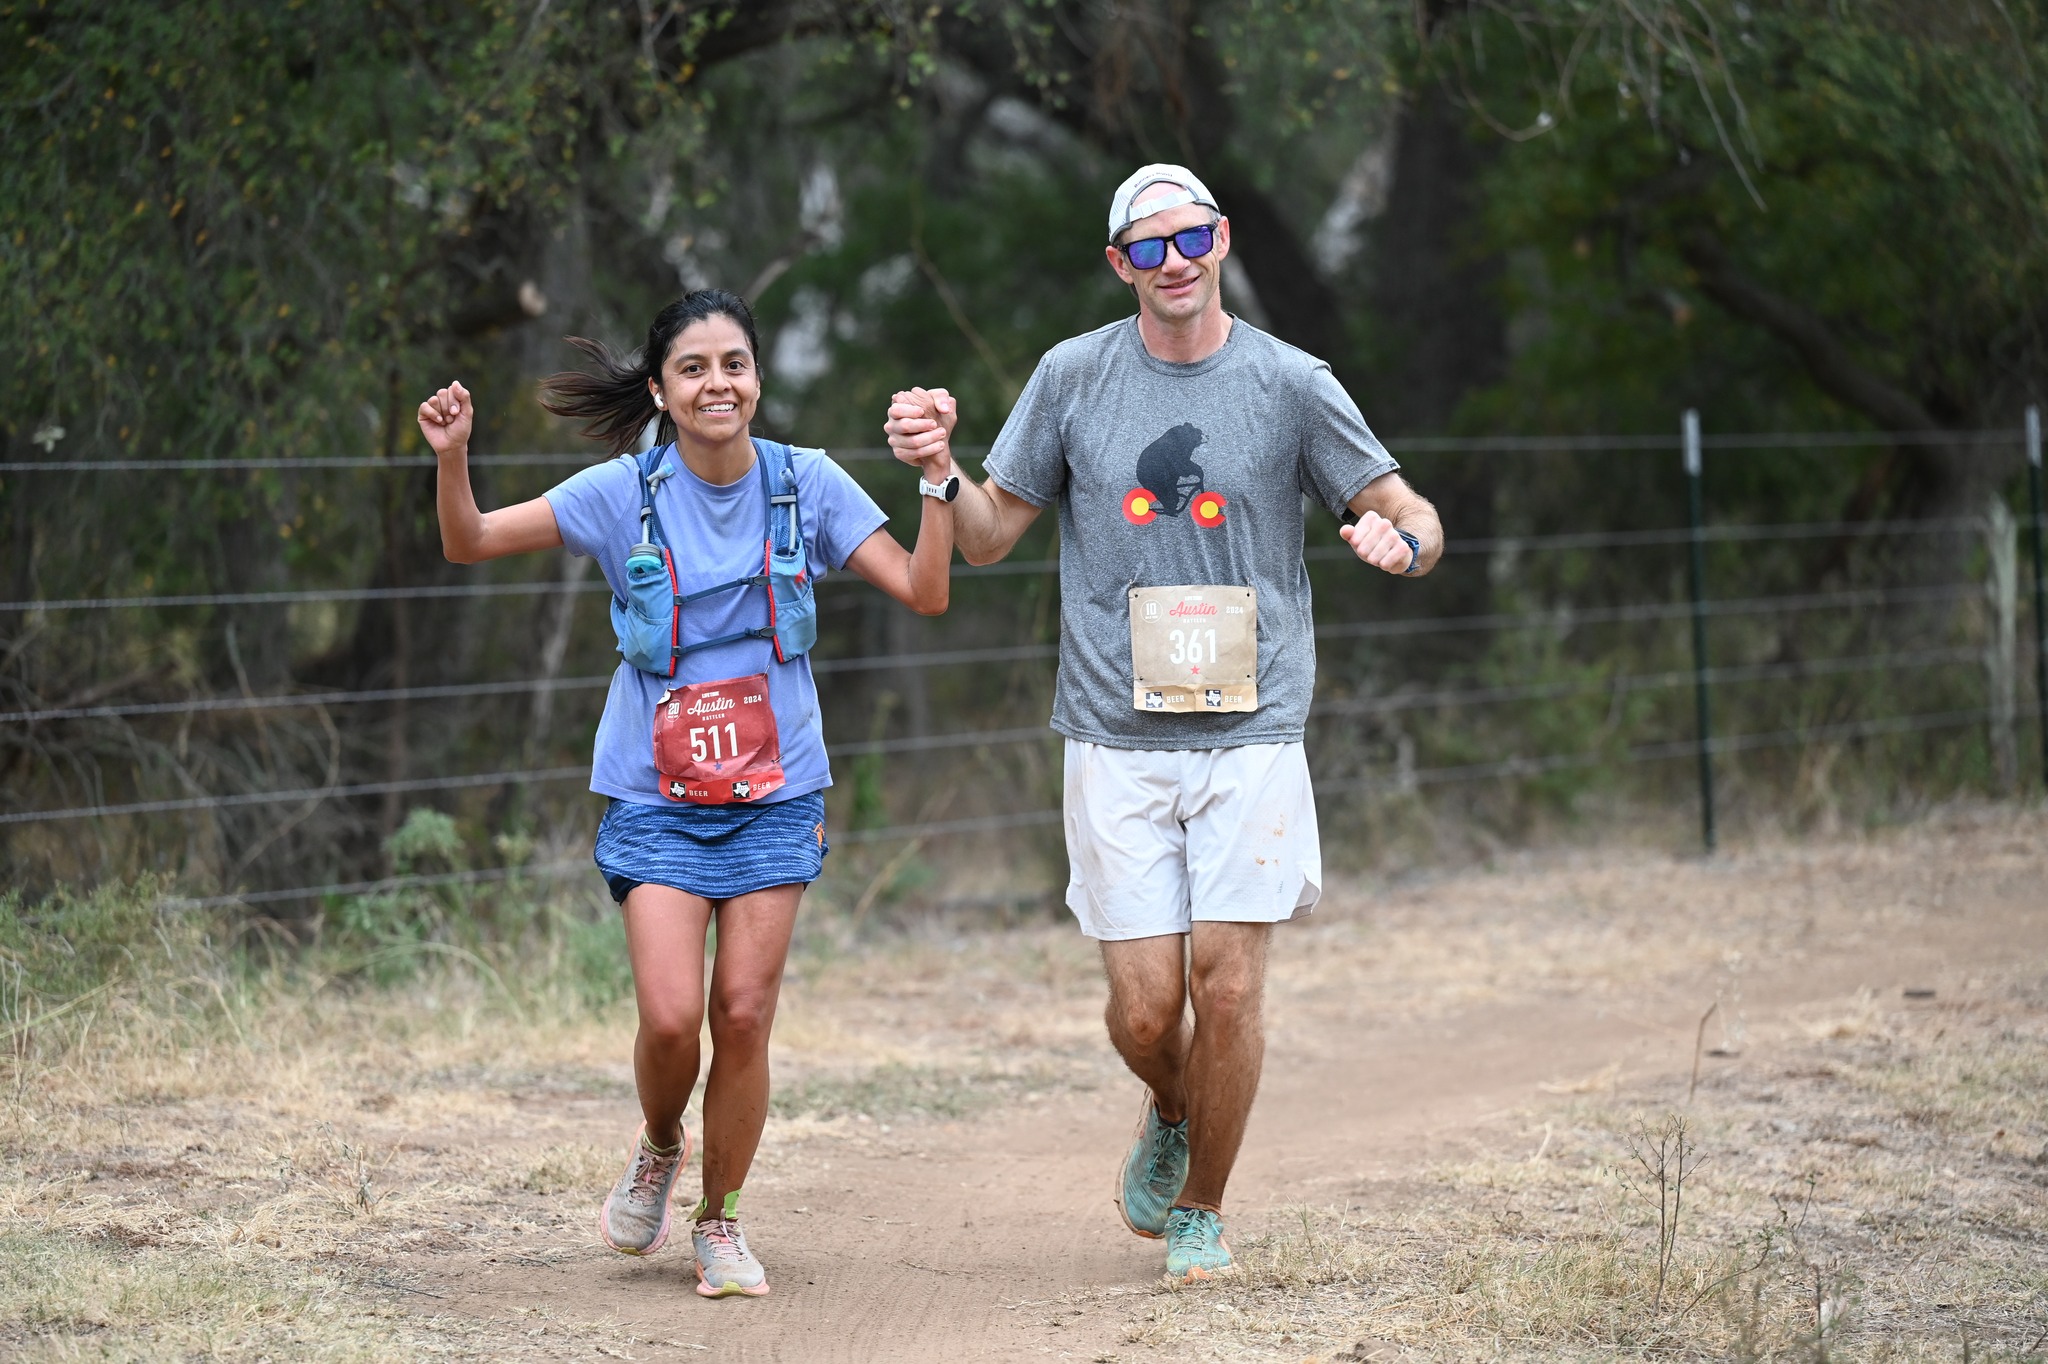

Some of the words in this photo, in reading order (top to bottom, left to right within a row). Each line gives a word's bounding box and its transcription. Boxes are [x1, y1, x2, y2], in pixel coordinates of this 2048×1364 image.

[1146, 603, 1156, 615] 10
[1170, 601, 1217, 616] Austin
[1170, 629, 1216, 664] 361
[743, 694, 762, 704] 2024
[1166, 695, 1185, 703] BEER
[668, 702, 680, 714] 20
[687, 697, 735, 715] Austin
[690, 722, 738, 762] 511
[752, 781, 771, 792] BEER
[689, 789, 708, 797] BEER
